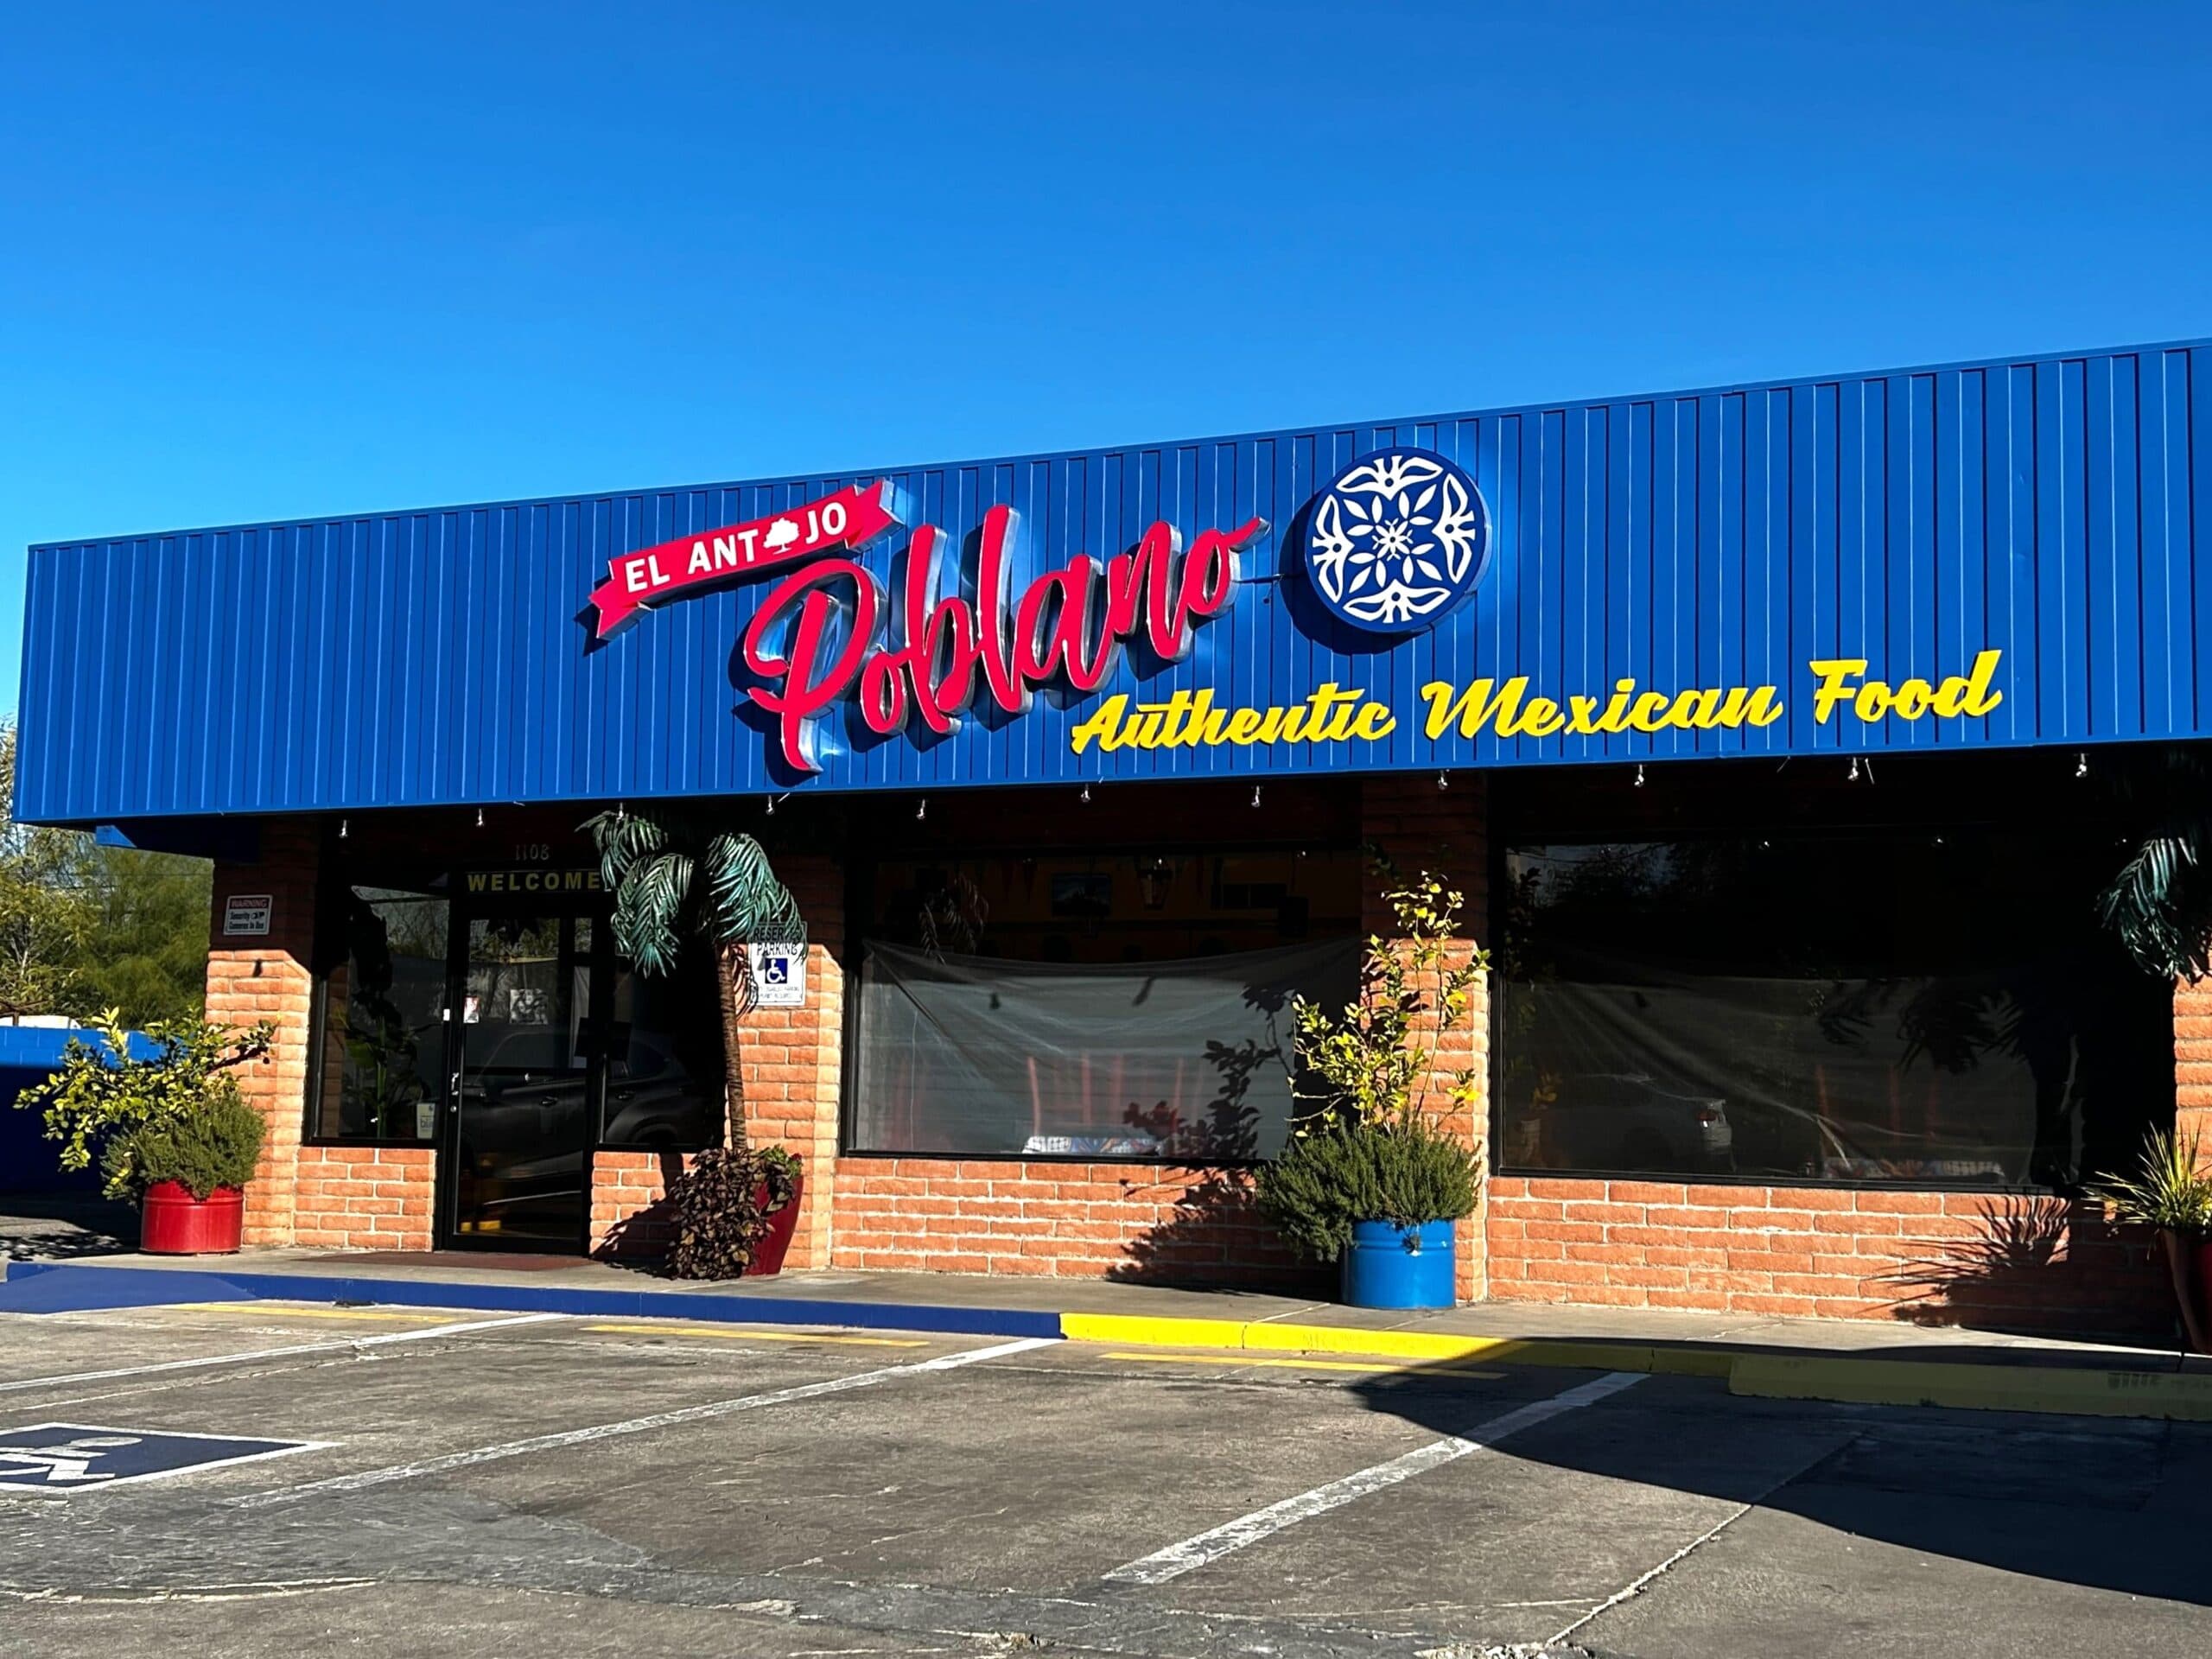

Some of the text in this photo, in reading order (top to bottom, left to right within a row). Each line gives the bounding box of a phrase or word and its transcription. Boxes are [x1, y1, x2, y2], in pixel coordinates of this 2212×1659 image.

[624, 502, 848, 594] EL ANTJO
[744, 505, 1264, 772] Poblano
[1071, 649, 2003, 753] Authentic Mexican Food
[467, 872, 601, 892] WELCOME
[756, 941, 798, 957] PARKING
